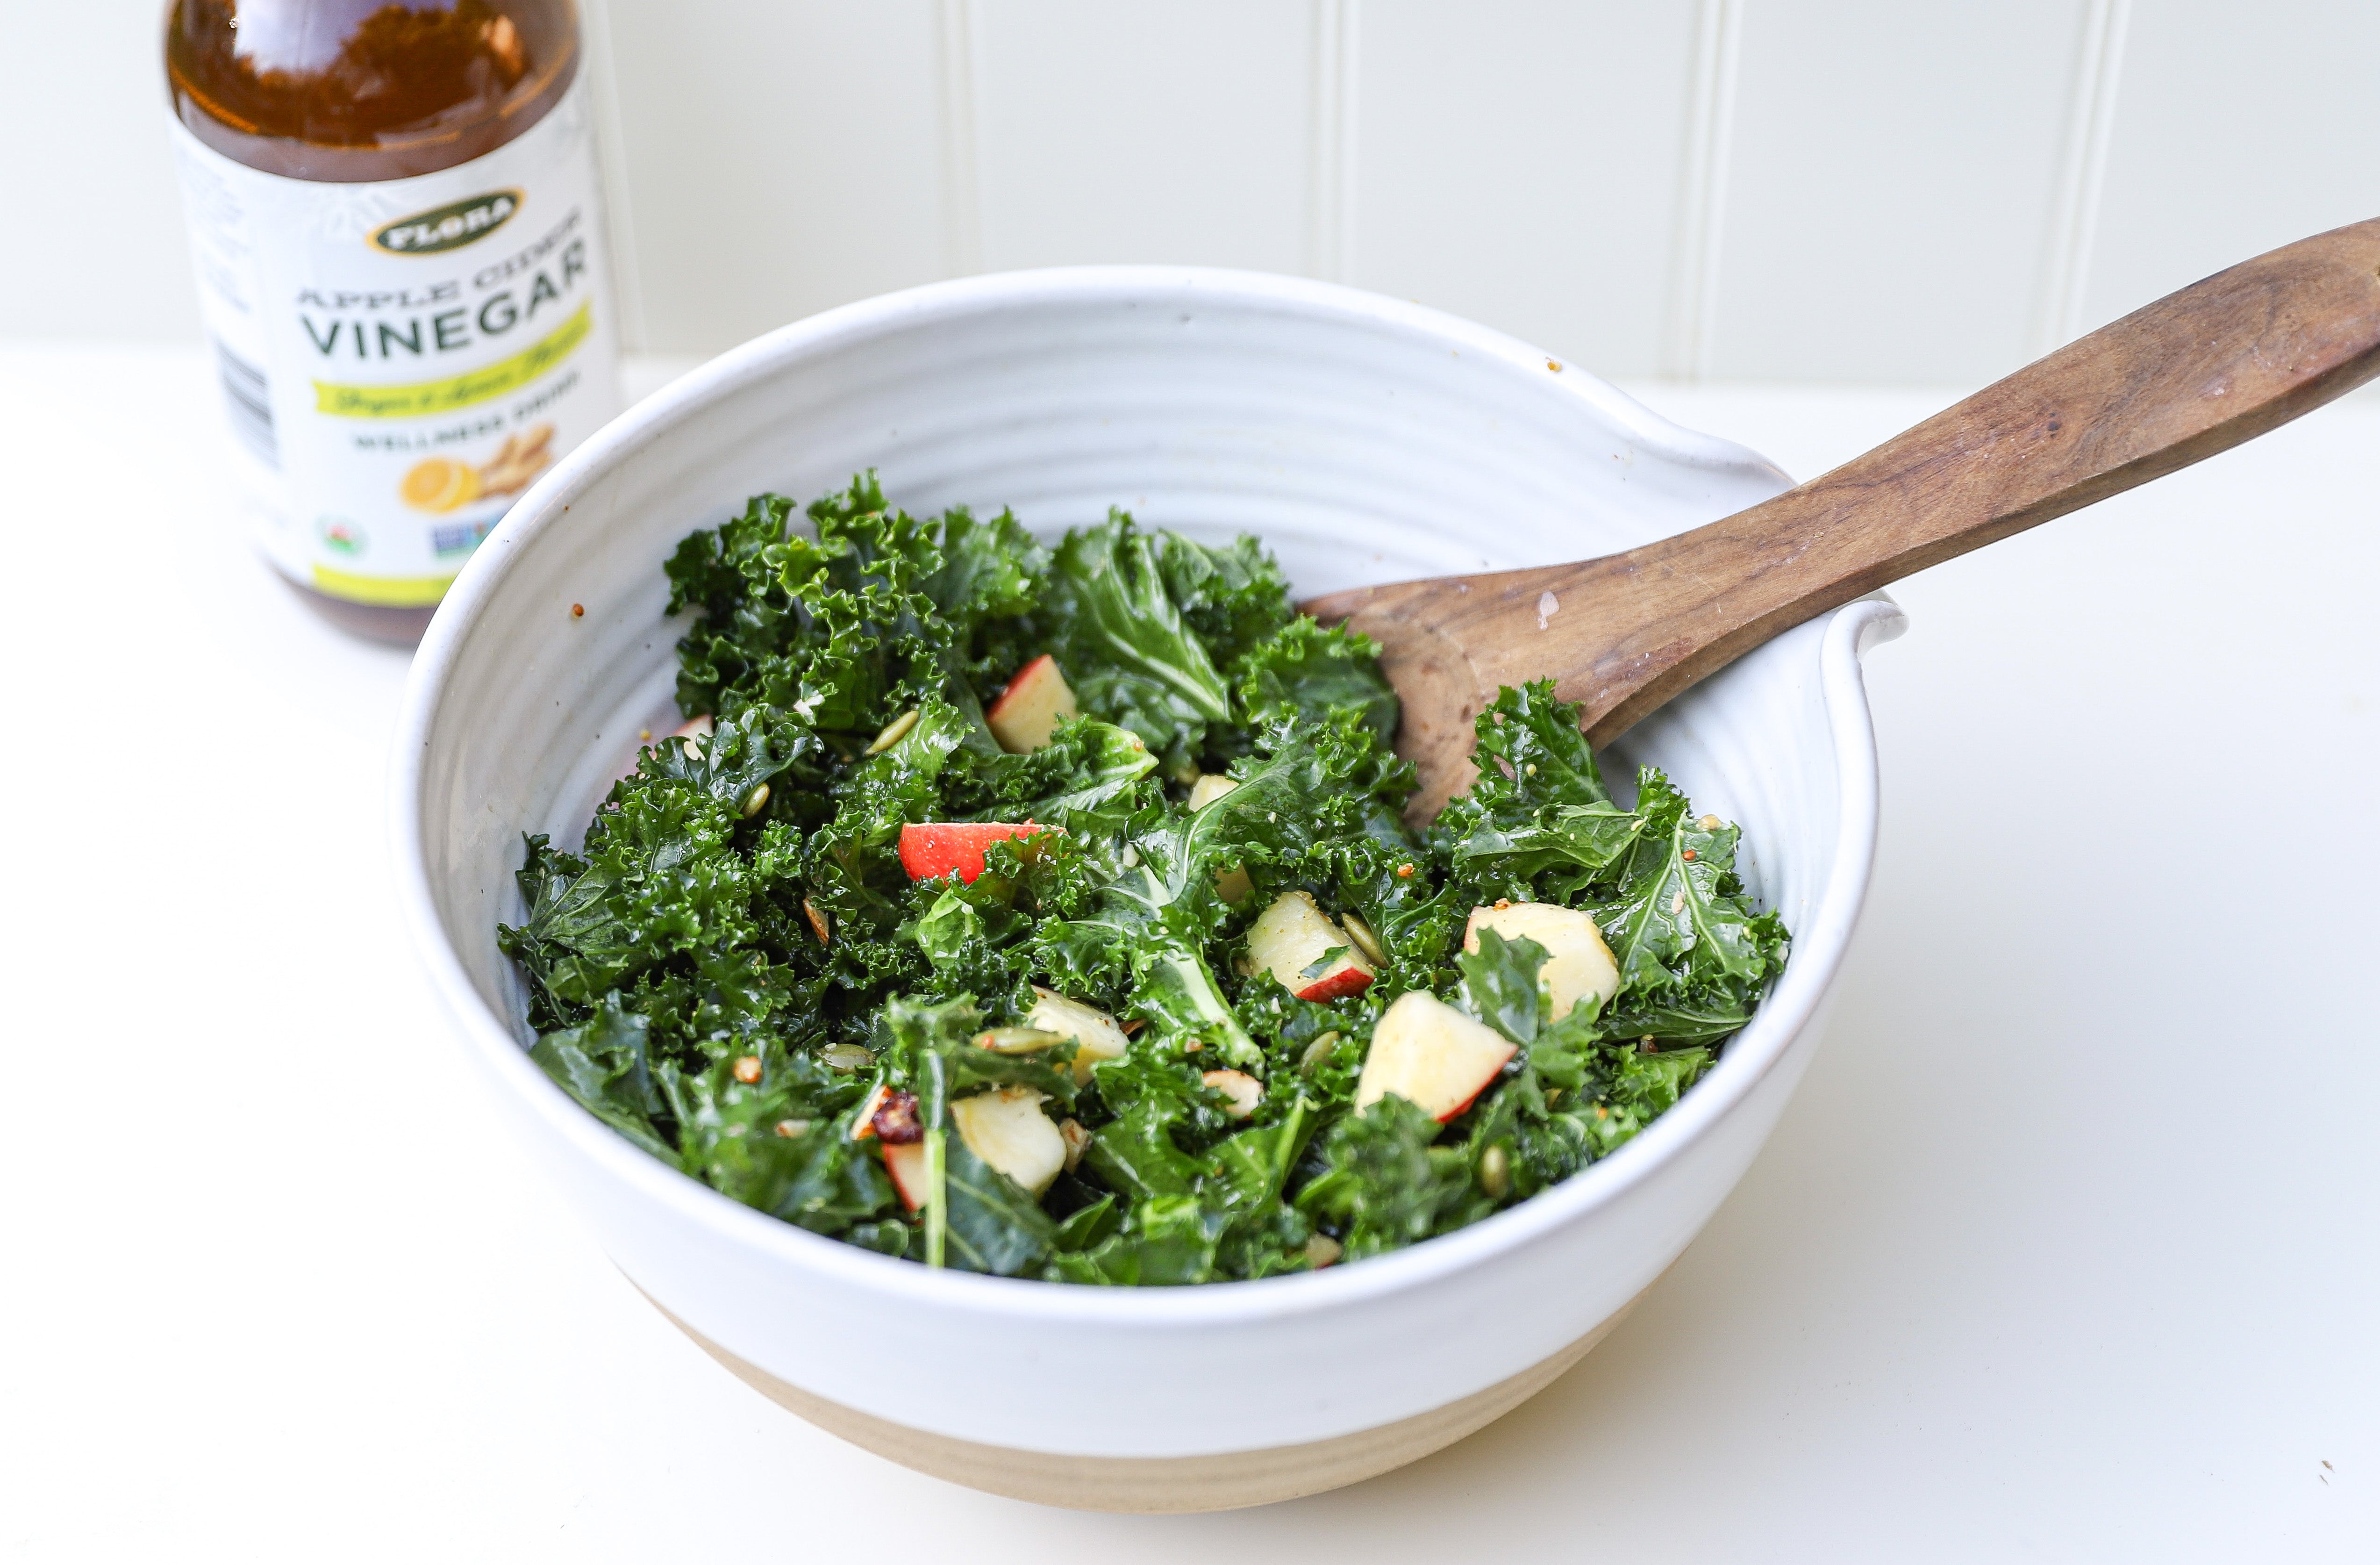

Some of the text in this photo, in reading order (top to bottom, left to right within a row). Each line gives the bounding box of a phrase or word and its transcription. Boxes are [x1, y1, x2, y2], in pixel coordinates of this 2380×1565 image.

[387, 197, 514, 250] FLORA
[297, 280, 461, 310] APPLE
[299, 237, 586, 359] VINEGAR
